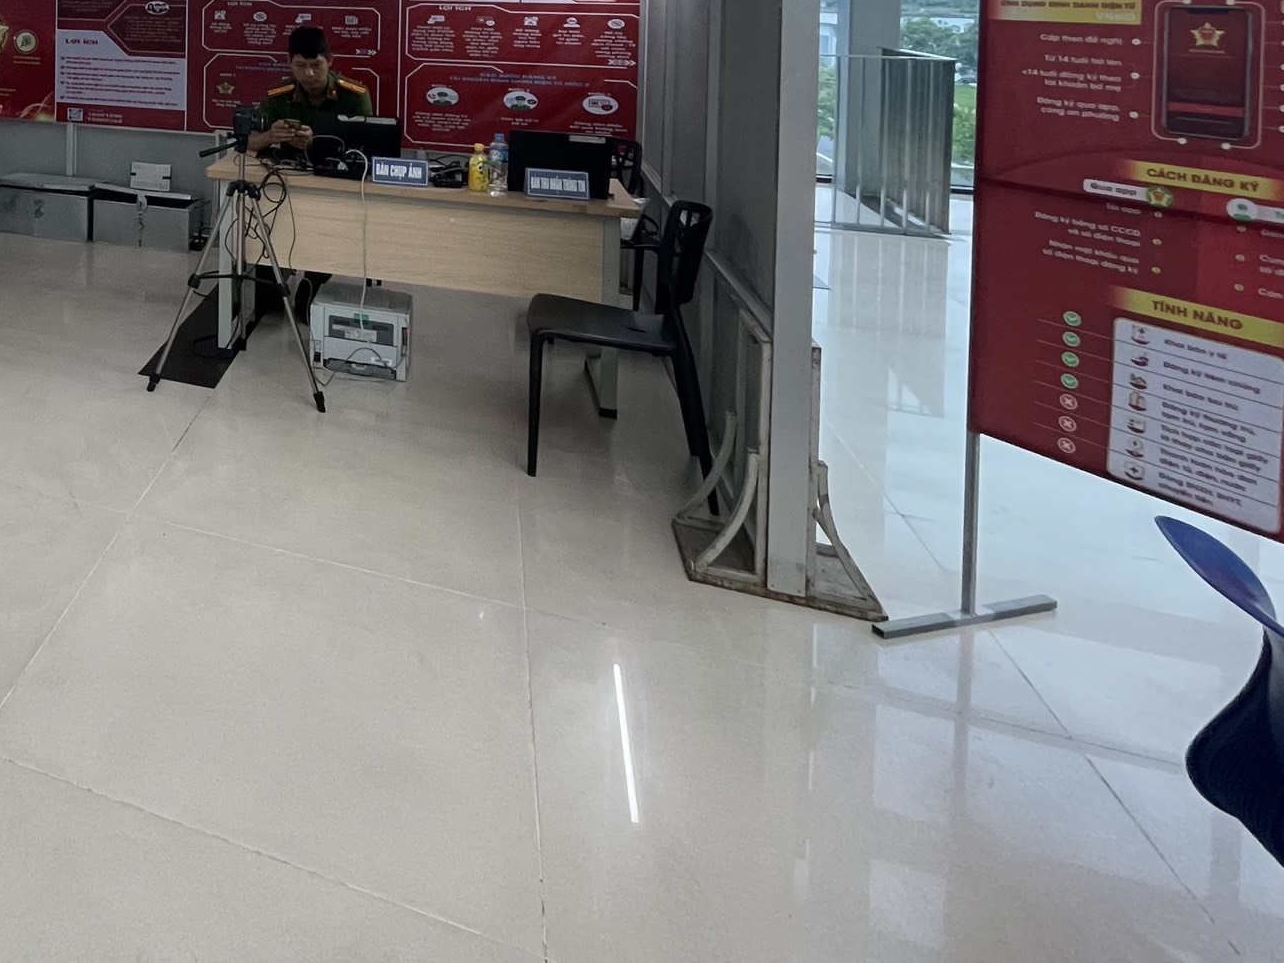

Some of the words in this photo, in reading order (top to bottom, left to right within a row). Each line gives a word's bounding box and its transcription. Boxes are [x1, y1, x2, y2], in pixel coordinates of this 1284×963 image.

[376, 161, 389, 176] BÀN
[389, 164, 407, 180] CHỤP
[408, 162, 422, 179] ẢNH
[1146, 167, 1187, 182] CÁCH
[1191, 173, 1235, 188] ĐĂNG
[1239, 180, 1260, 192] KÝ
[1151, 299, 1188, 318] TÍNH
[1192, 309, 1243, 330] NĂNG
